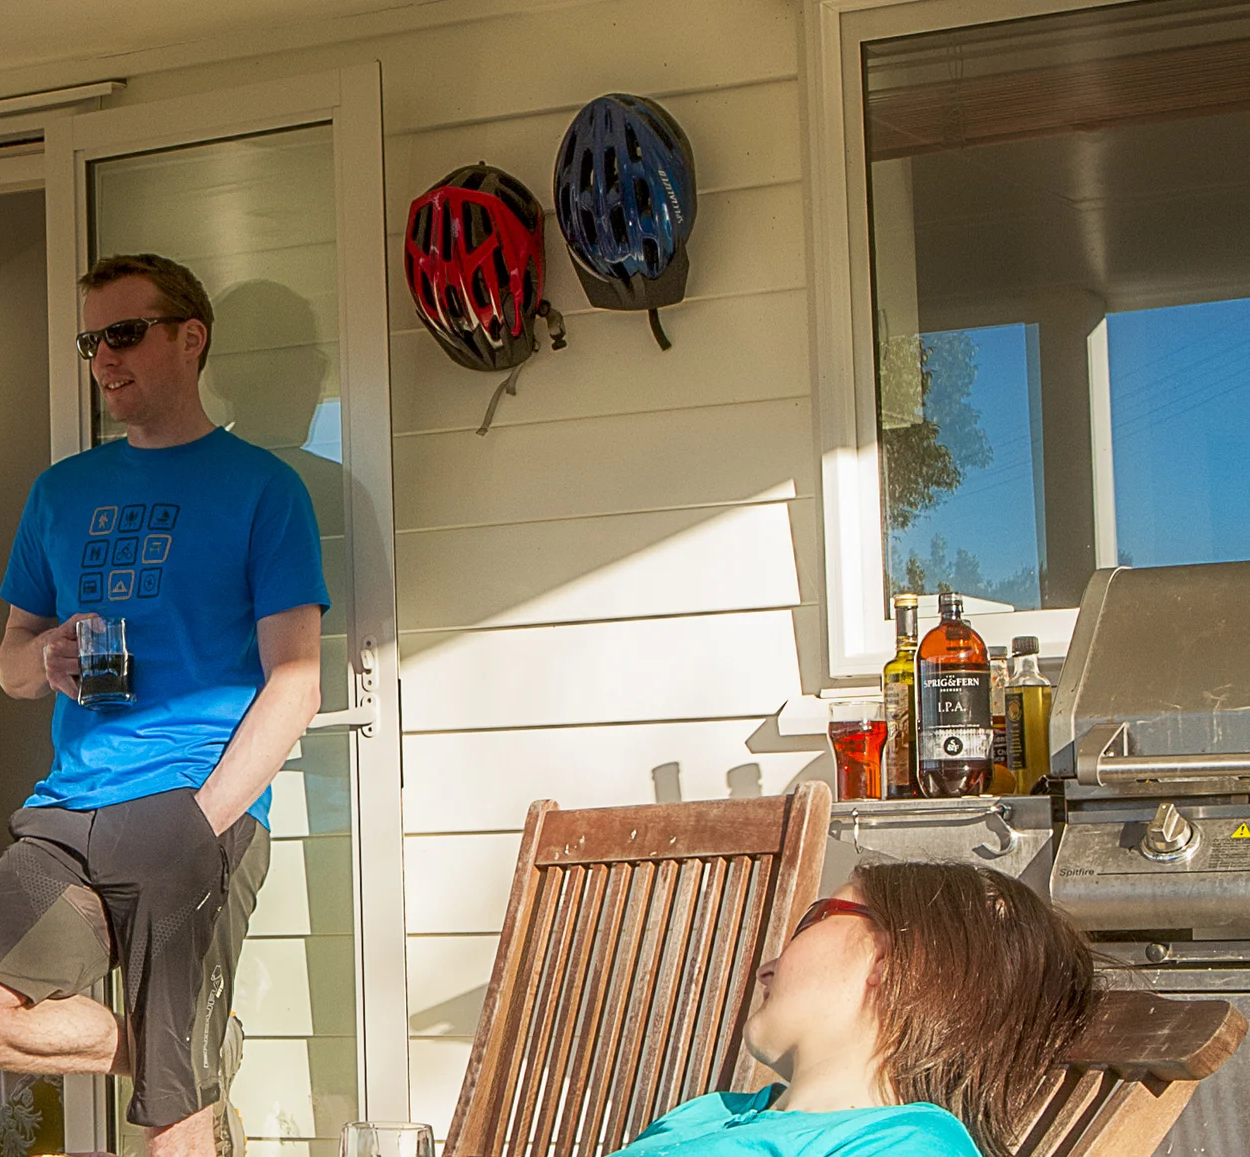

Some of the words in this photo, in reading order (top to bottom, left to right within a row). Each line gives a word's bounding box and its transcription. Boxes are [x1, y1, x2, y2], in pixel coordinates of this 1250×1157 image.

[924, 677, 979, 688] SPRIG&FERN
[938, 701, 967, 712] I.P.A.
[1059, 868, 1095, 879] Spitfire
